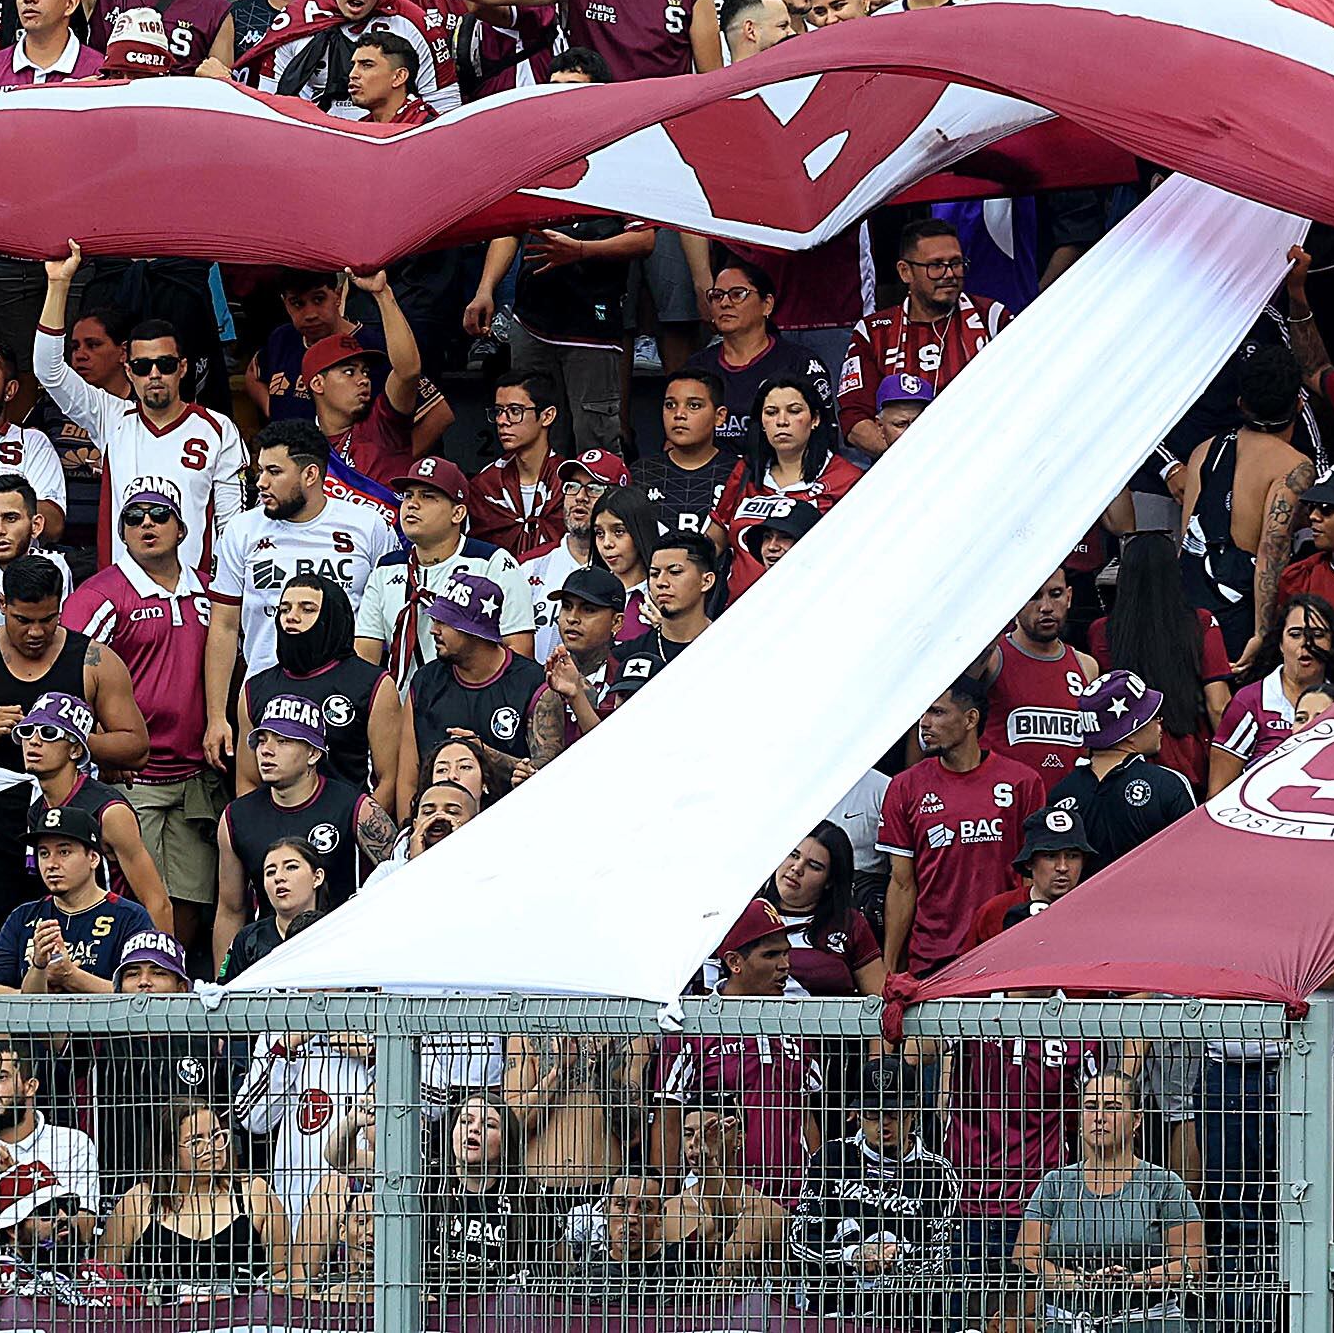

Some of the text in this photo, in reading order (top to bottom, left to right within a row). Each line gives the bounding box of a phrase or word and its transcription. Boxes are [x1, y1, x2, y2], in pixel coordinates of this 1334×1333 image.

[322, 474, 398, 526] Colgate
[296, 559, 353, 583] BAC
[960, 820, 1004, 837] BAC
[1217, 807, 1305, 836] COSTA
